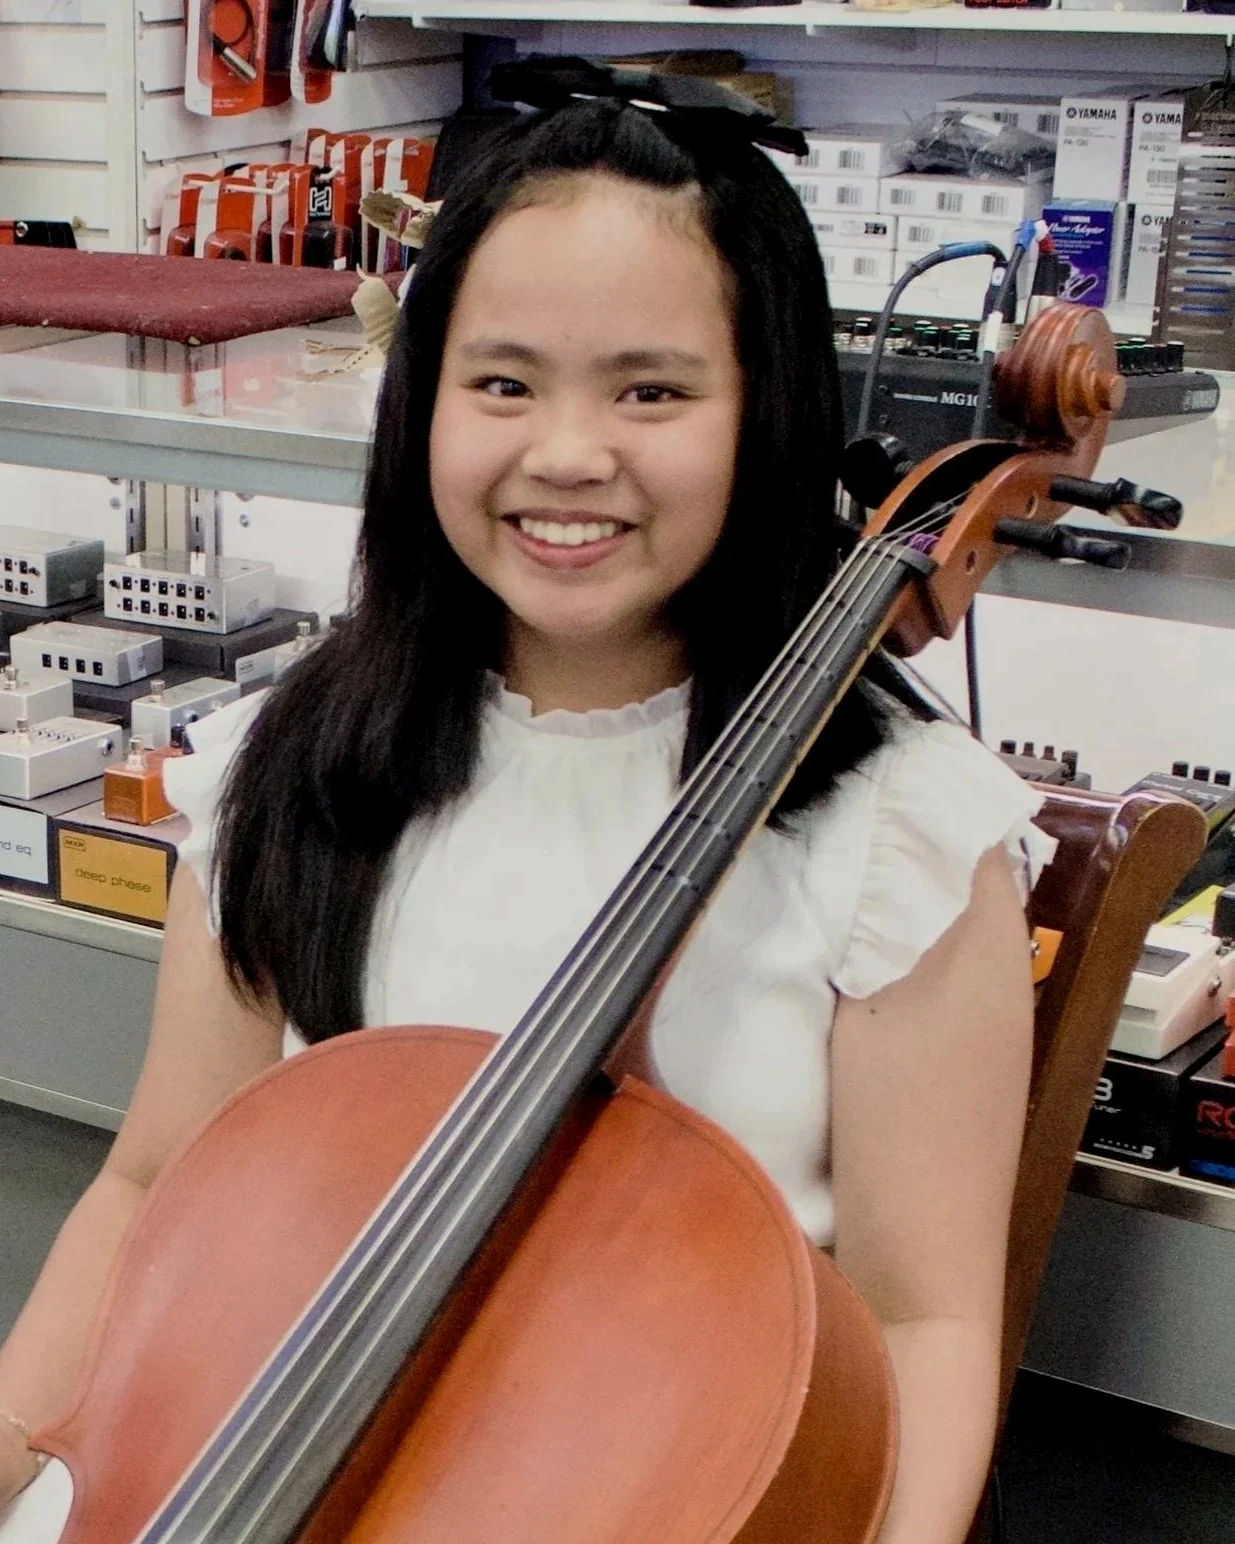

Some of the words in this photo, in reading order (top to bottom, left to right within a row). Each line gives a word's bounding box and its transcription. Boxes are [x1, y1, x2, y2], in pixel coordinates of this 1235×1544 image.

[1078, 107, 1117, 121] YAMAHA
[16, 842, 32, 857] eq
[75, 866, 107, 884] deep
[111, 876, 152, 893] phase
